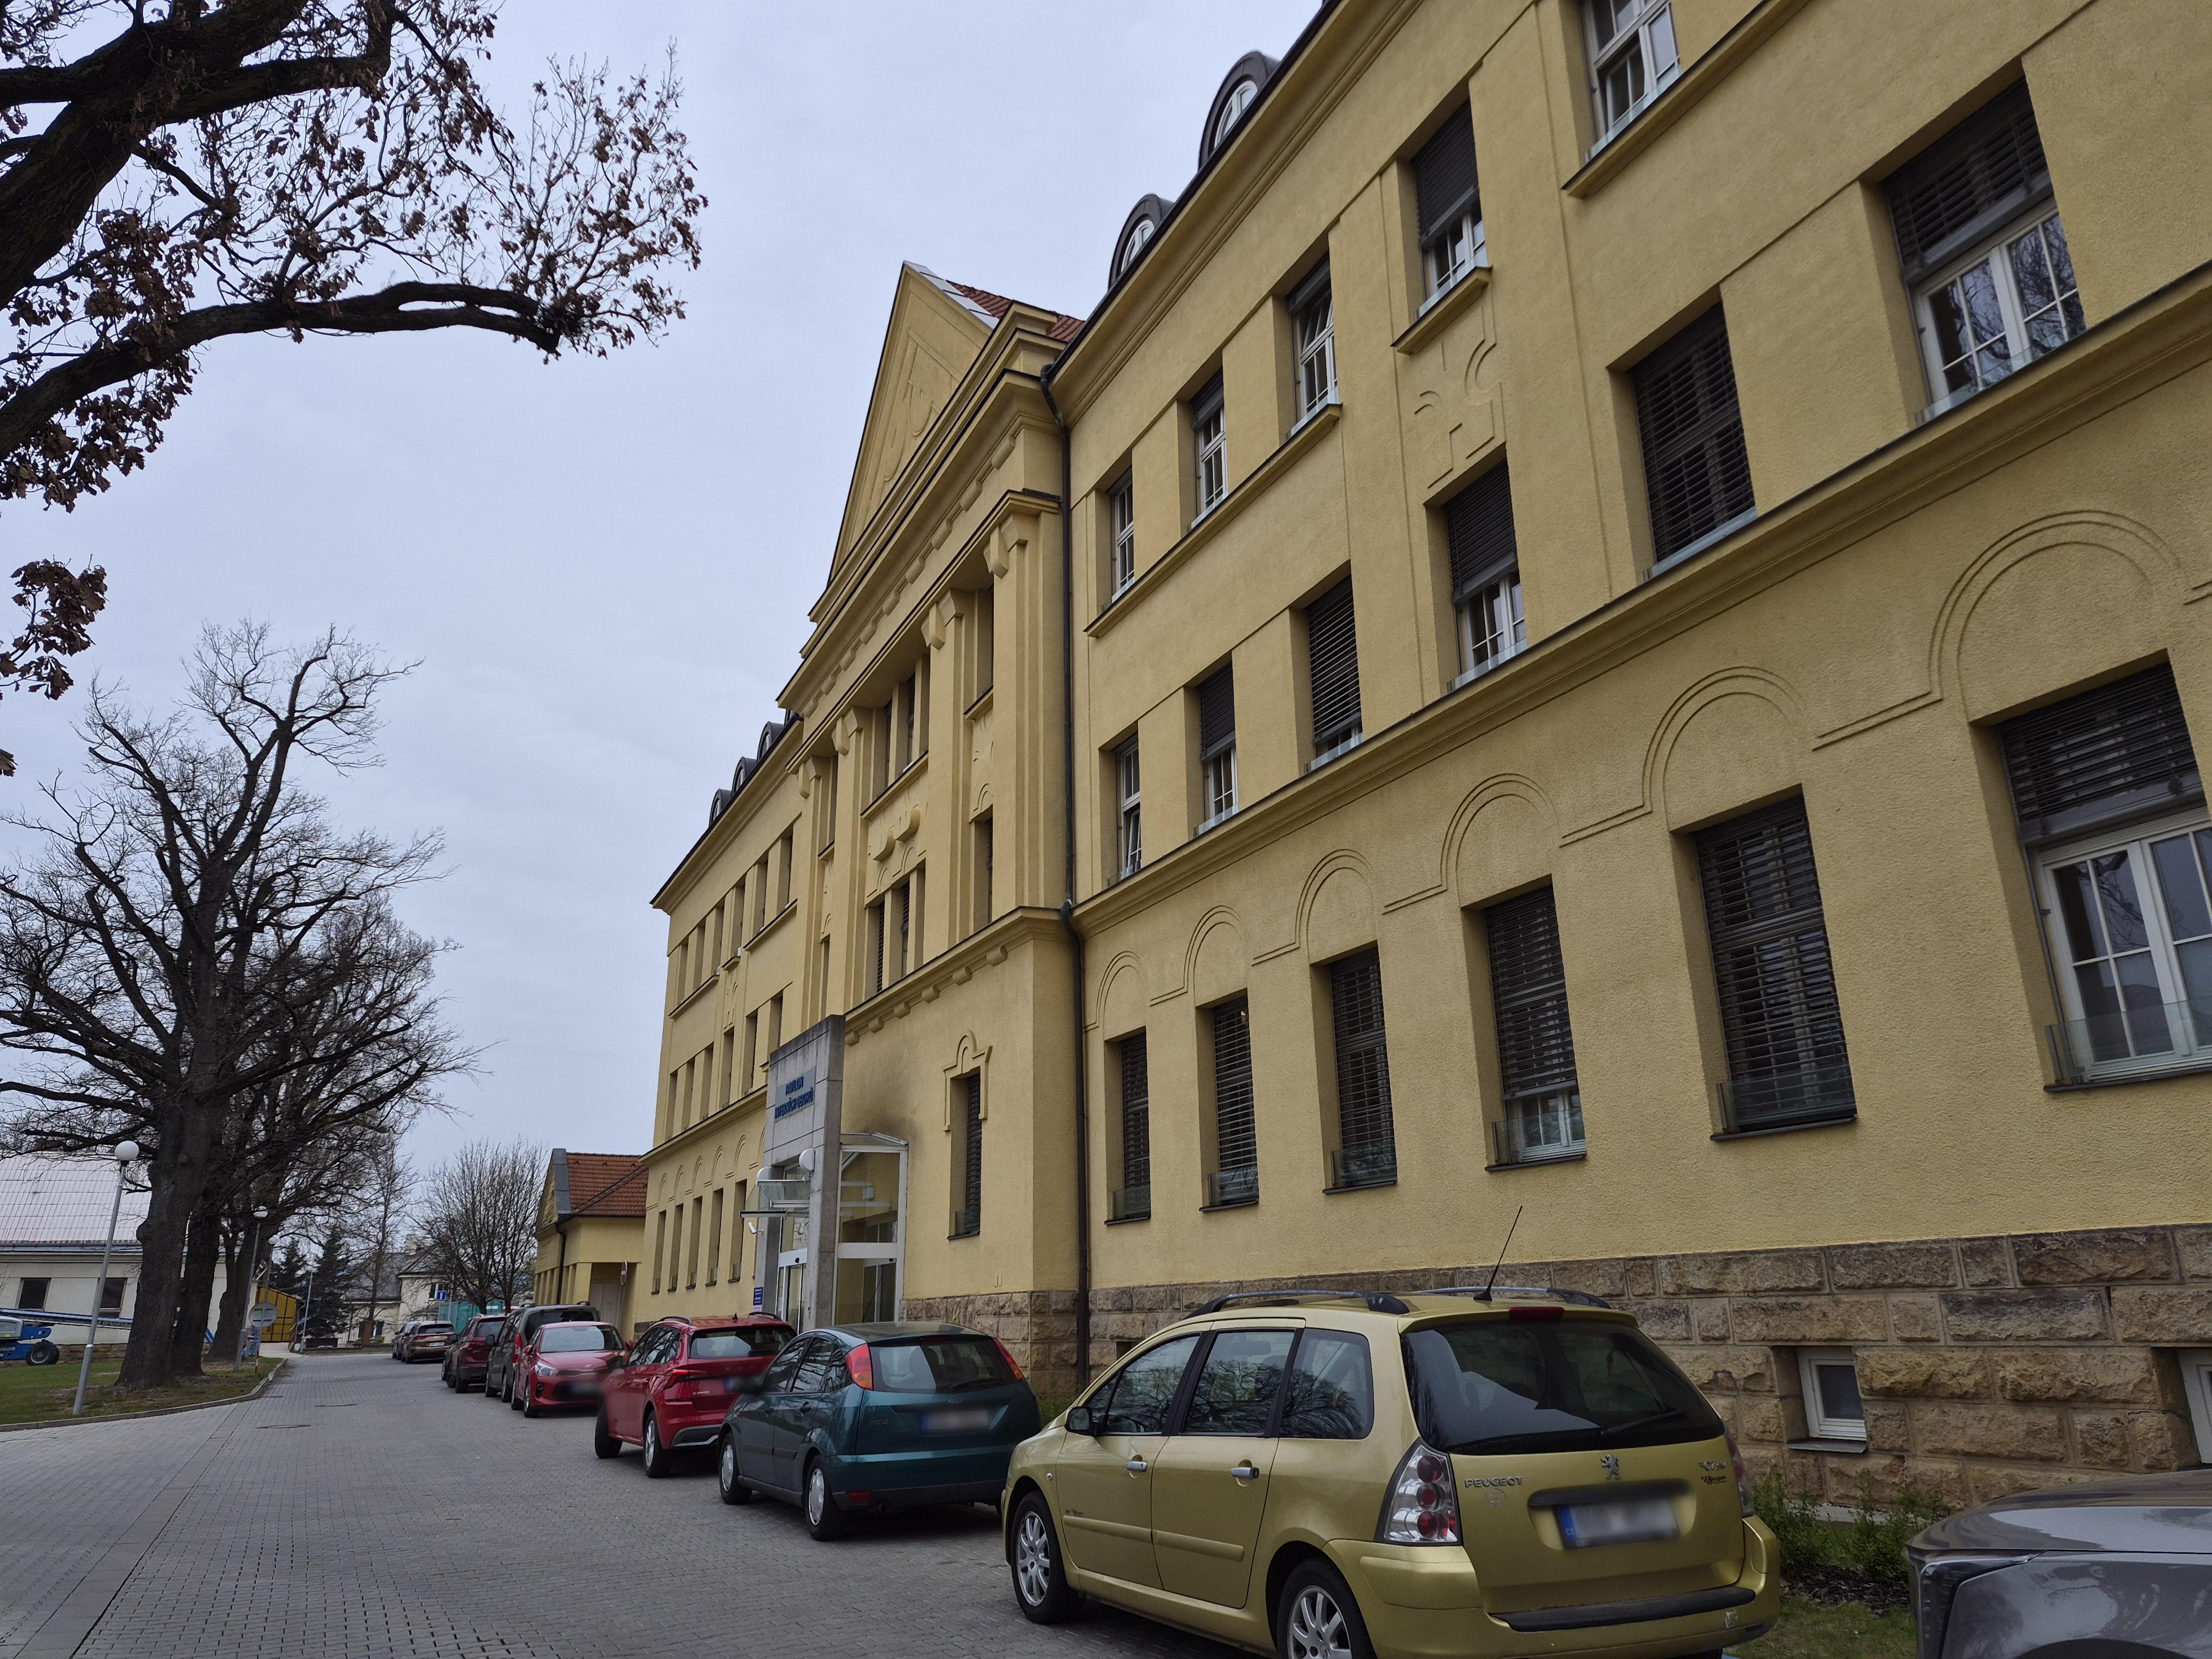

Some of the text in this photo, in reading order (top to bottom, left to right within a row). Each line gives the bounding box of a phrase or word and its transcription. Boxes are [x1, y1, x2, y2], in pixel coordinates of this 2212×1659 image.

[785, 1076, 804, 1095] PAVILON
[774, 1087, 814, 1119] INTERNÍCH OBORŮ
[1464, 1476, 1523, 1488] PEUGEOT
[1489, 1493, 1502, 1503] CZ
[1565, 1527, 1575, 1536] CZ
